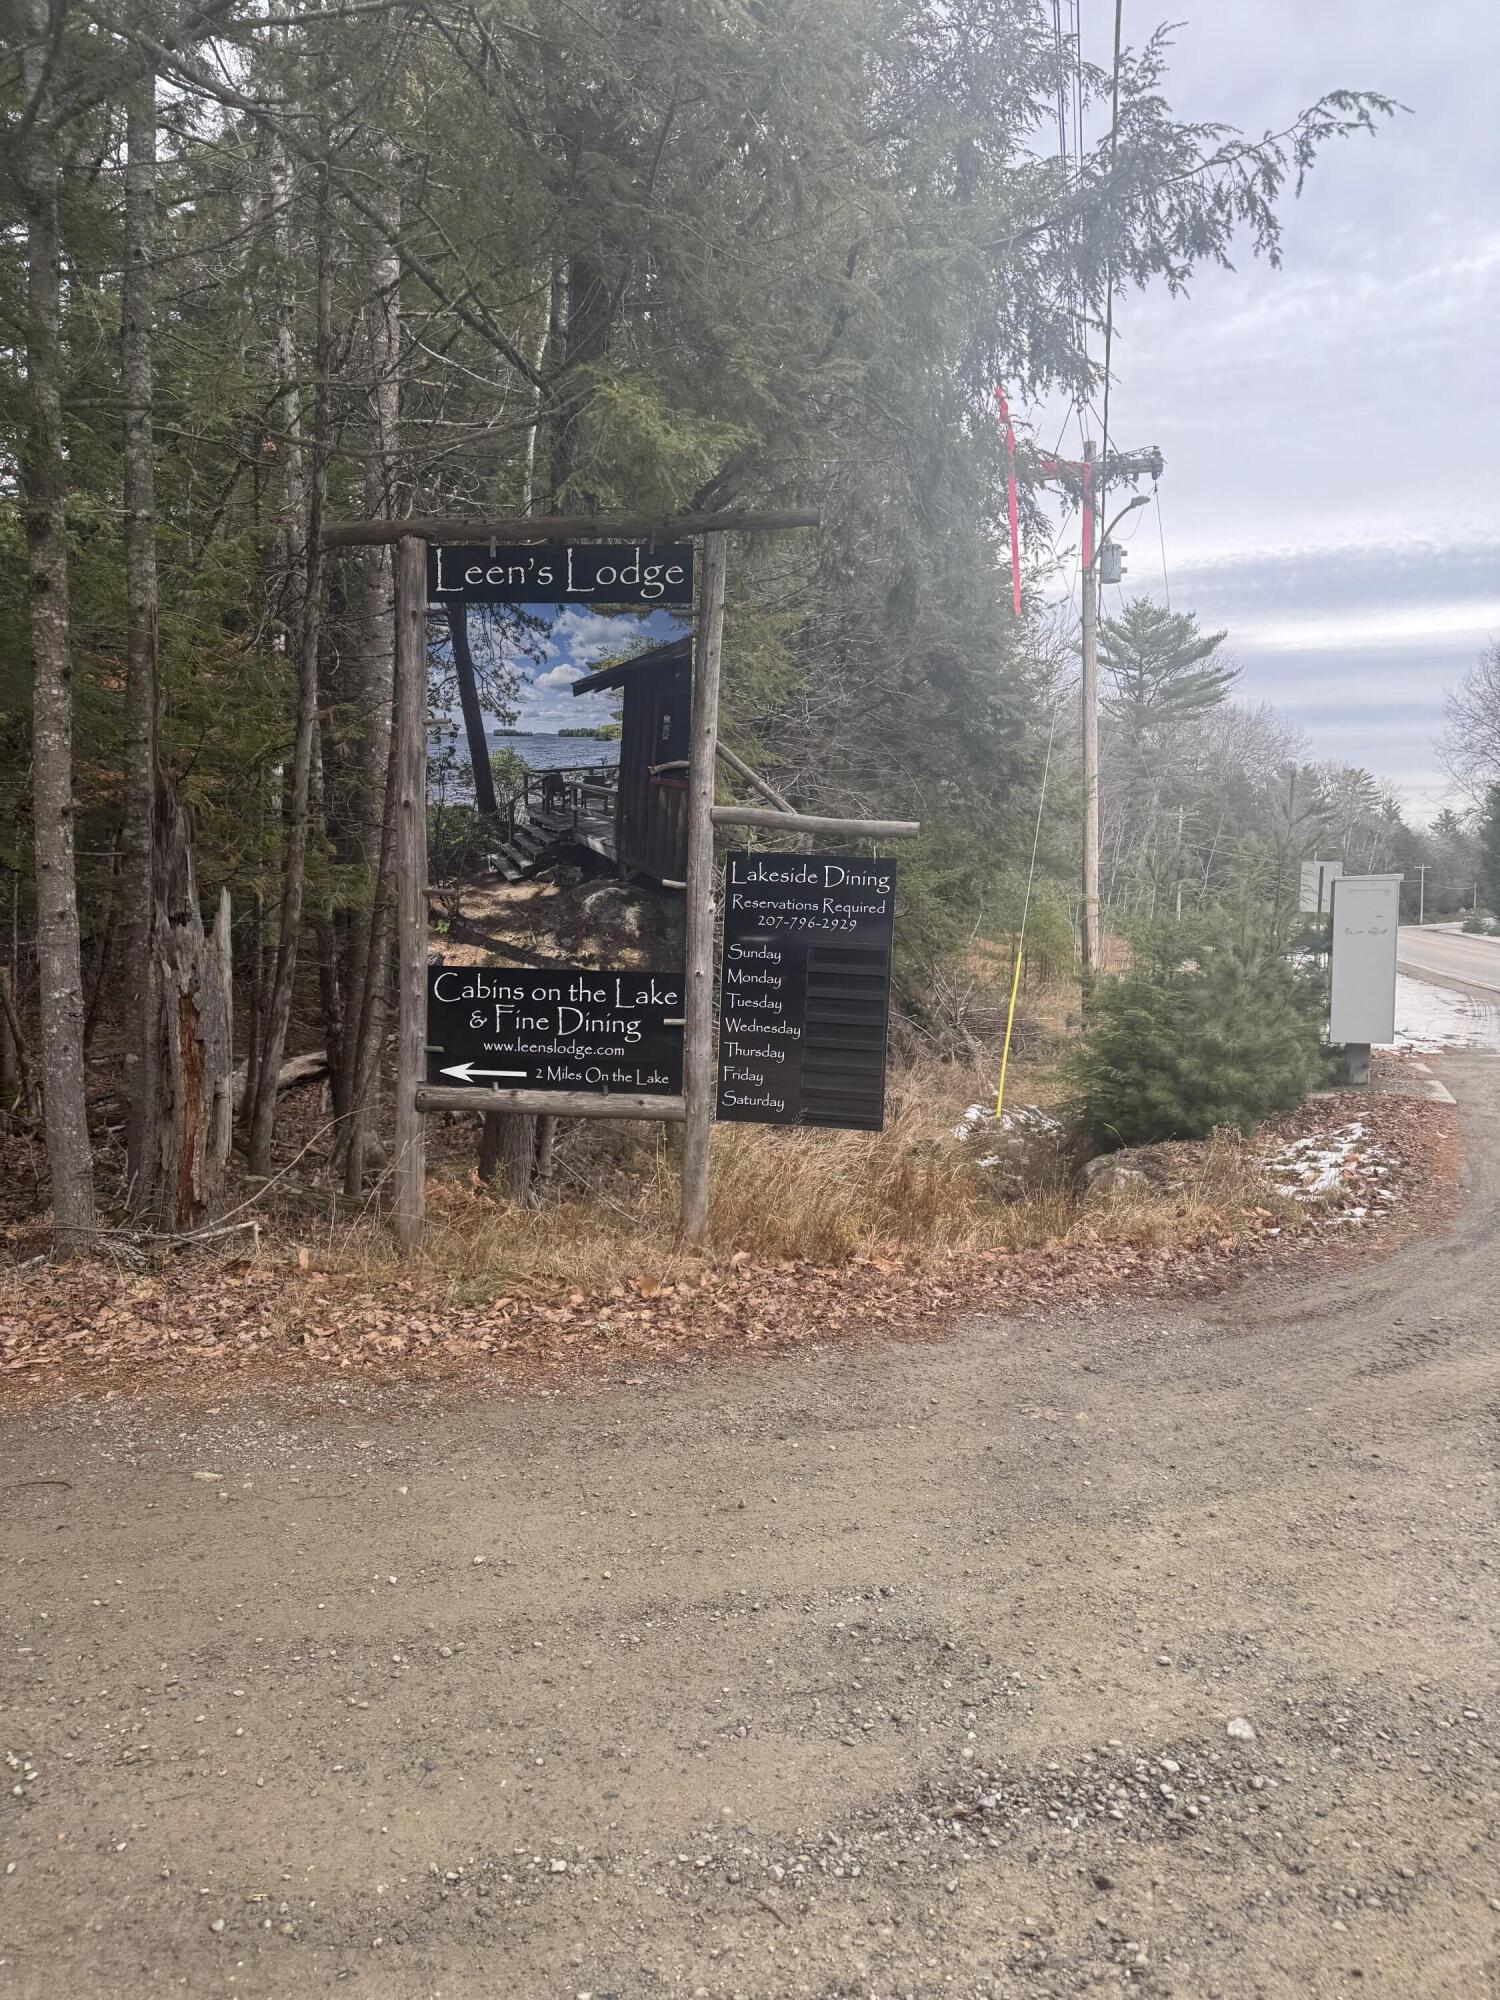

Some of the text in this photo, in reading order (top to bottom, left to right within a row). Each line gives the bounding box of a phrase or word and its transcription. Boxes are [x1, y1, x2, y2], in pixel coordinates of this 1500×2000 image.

[436, 547, 685, 598] Leen's Lodge
[731, 861, 890, 894] Lakeside Dining
[732, 893, 886, 918] Reservations Required
[758, 915, 857, 932] 207-796-2929
[727, 943, 782, 964] Sunday
[727, 968, 782, 989] Monday
[434, 972, 678, 1008] Cabins on the Lake
[726, 992, 782, 1014] Tuesday
[469, 1004, 642, 1043] & Fine Dining
[725, 1017, 801, 1040] Wednesday
[483, 1037, 625, 1060] www.leenslodge.com
[724, 1041, 785, 1063] Thursday
[536, 1066, 670, 1086] 2 Miles On the Lake
[723, 1066, 764, 1086] Friday
[721, 1091, 785, 1112] Saturday
